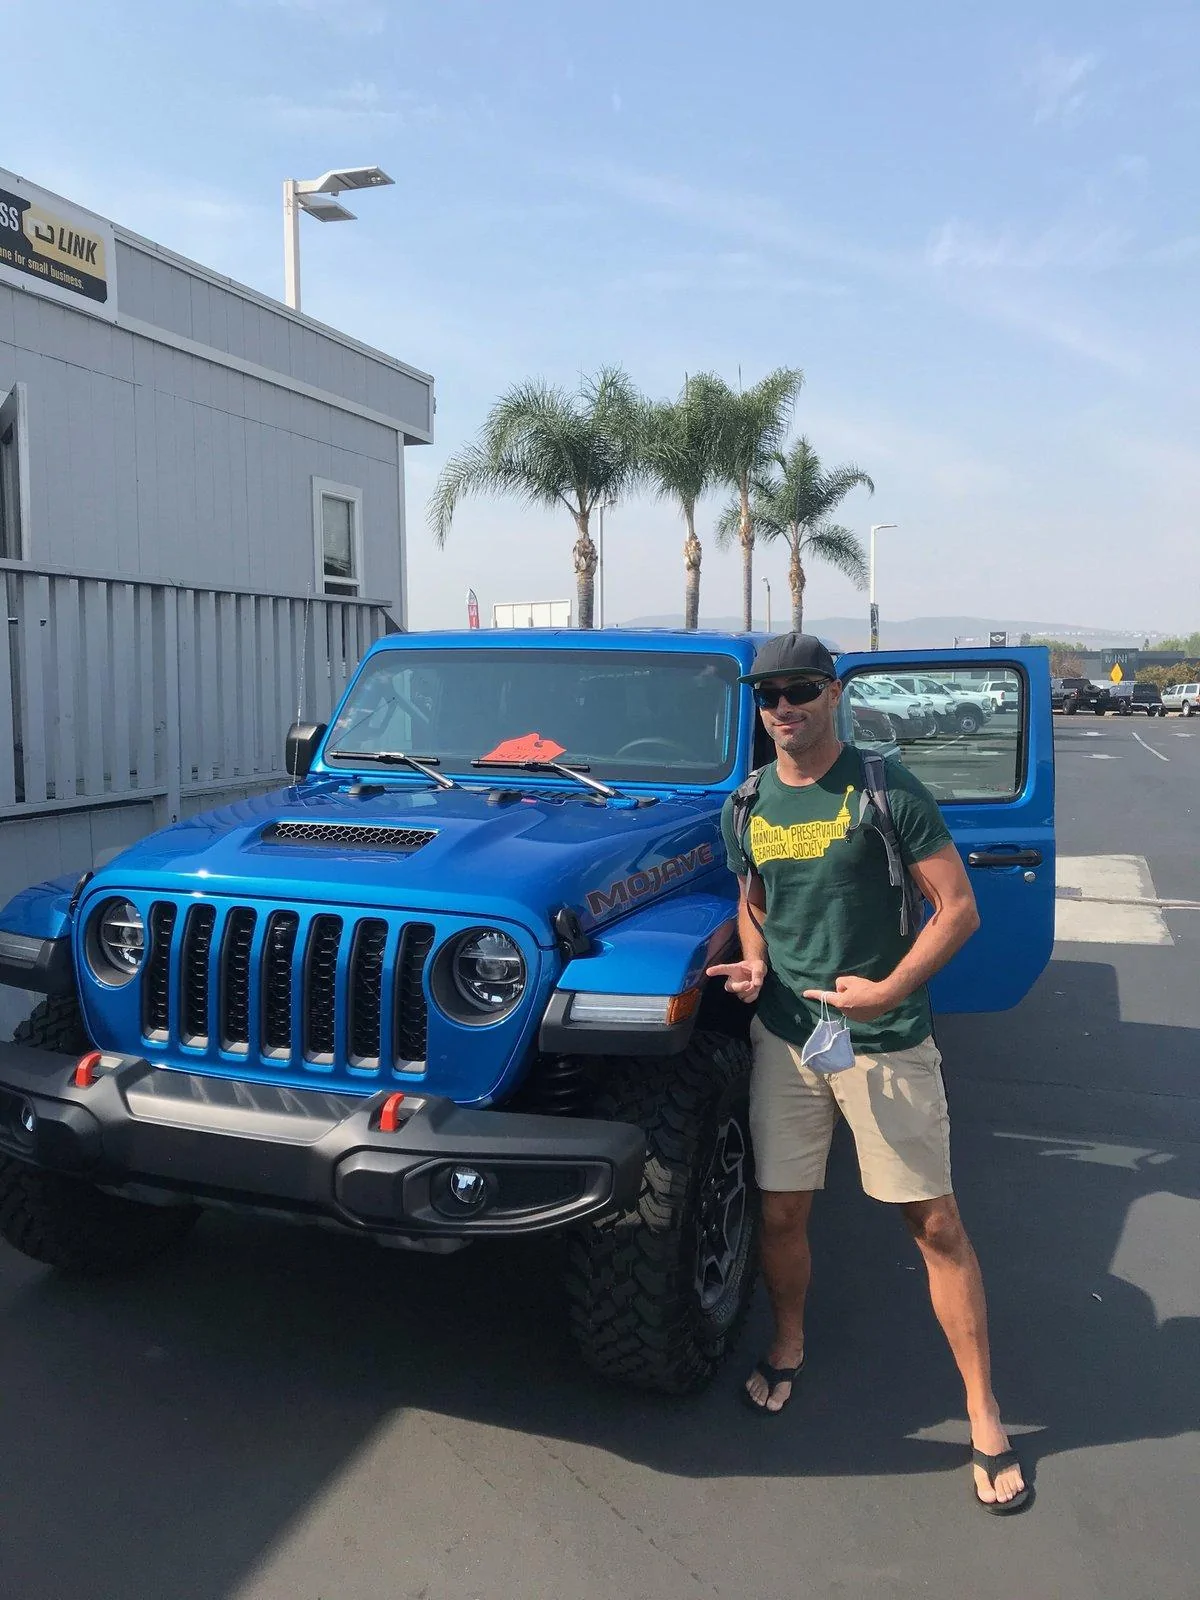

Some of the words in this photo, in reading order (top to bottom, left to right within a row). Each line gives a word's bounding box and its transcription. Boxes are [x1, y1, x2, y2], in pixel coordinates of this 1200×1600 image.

[58, 227, 98, 265] LINK
[14, 250, 26, 266] for
[27, 258, 49, 275] small
[51, 264, 84, 290] business.
[753, 818, 764, 831] THE
[752, 827, 784, 845] MANUAL
[754, 842, 788, 862] GEARBOX
[792, 839, 824, 858] SOCIETY
[585, 842, 714, 917] MOJAVE
